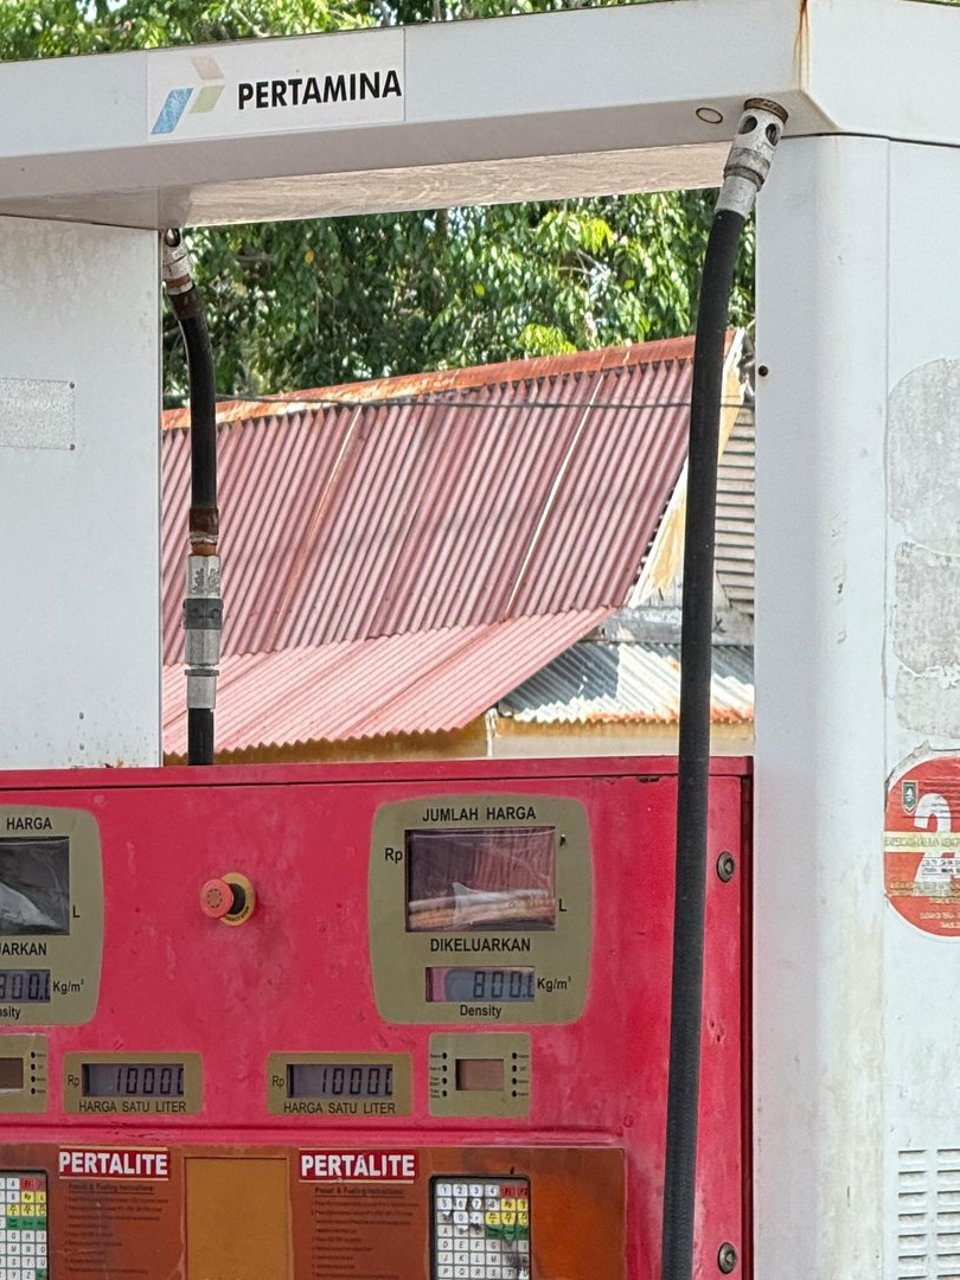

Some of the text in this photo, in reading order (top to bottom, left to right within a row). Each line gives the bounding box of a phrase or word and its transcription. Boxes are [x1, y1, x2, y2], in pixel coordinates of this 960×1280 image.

[238, 69, 402, 110] PERTAMINA
[422, 806, 537, 822] JUMLAH HARGA
[6, 816, 52, 831] HARGA
[385, 848, 403, 863] Rp
[72, 905, 81, 918] L
[558, 898, 567, 912] L
[430, 938, 531, 952] DIKELUARKAN
[459, 1004, 502, 1019] Density
[67, 1074, 80, 1088] Rp
[271, 1075, 285, 1089] Rp
[79, 1101, 187, 1113] HARGA SATU LITER
[283, 1102, 396, 1115] HARGA SATU LITER
[59, 1151, 168, 1176] PERTALITE
[300, 1154, 416, 1177] PERTALITE
